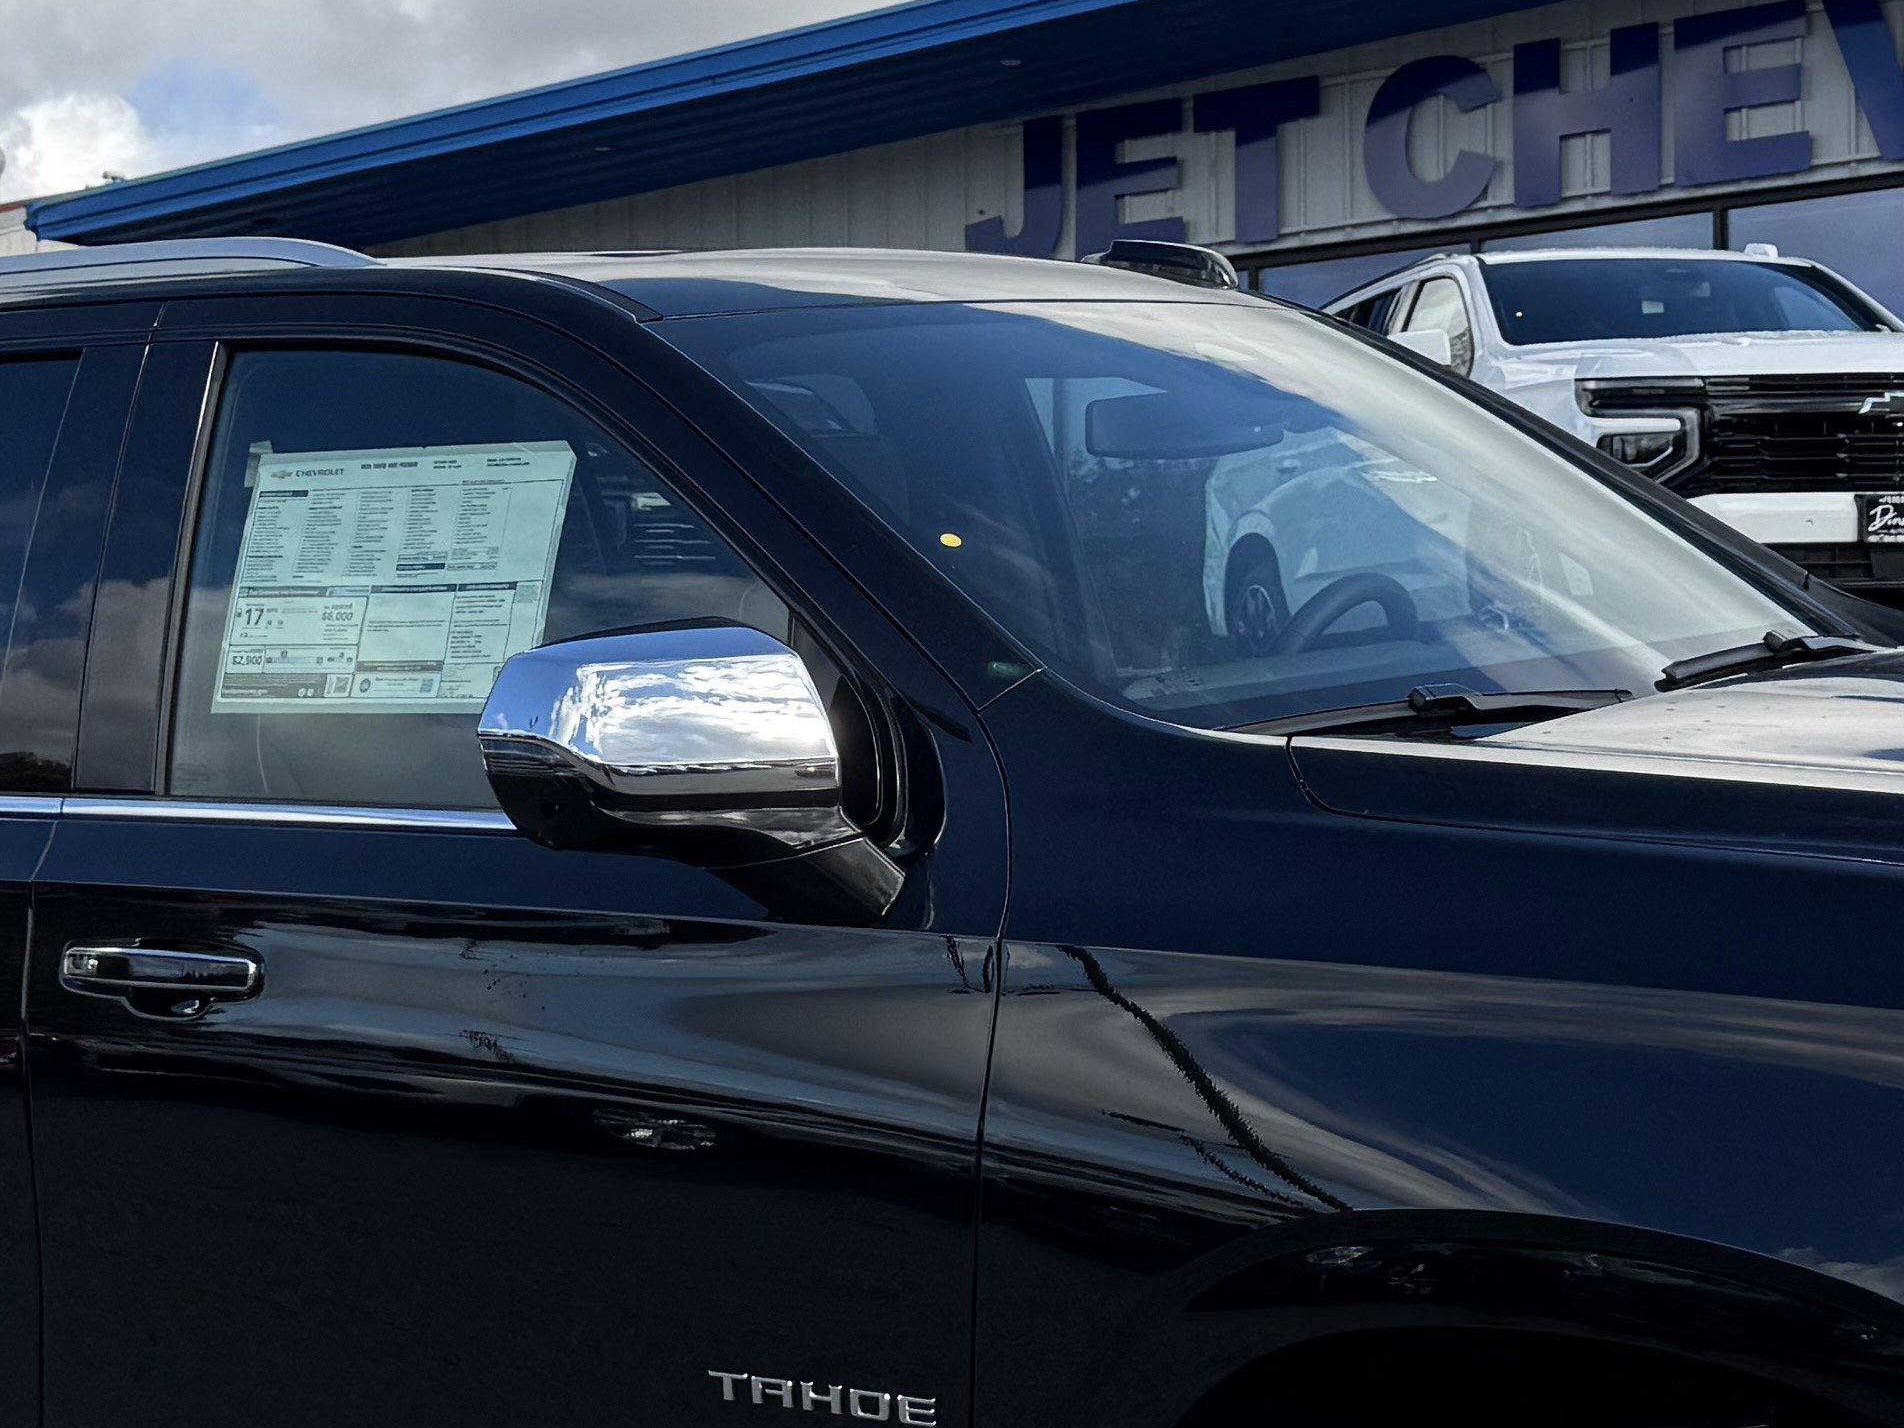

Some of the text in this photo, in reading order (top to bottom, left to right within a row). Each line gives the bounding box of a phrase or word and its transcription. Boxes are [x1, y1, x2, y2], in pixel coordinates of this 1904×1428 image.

[965, 75, 1320, 260] JET
[296, 468, 345, 477] CHEVROLET
[244, 607, 265, 626] 17
[707, 1370, 938, 1427] TAHOE
